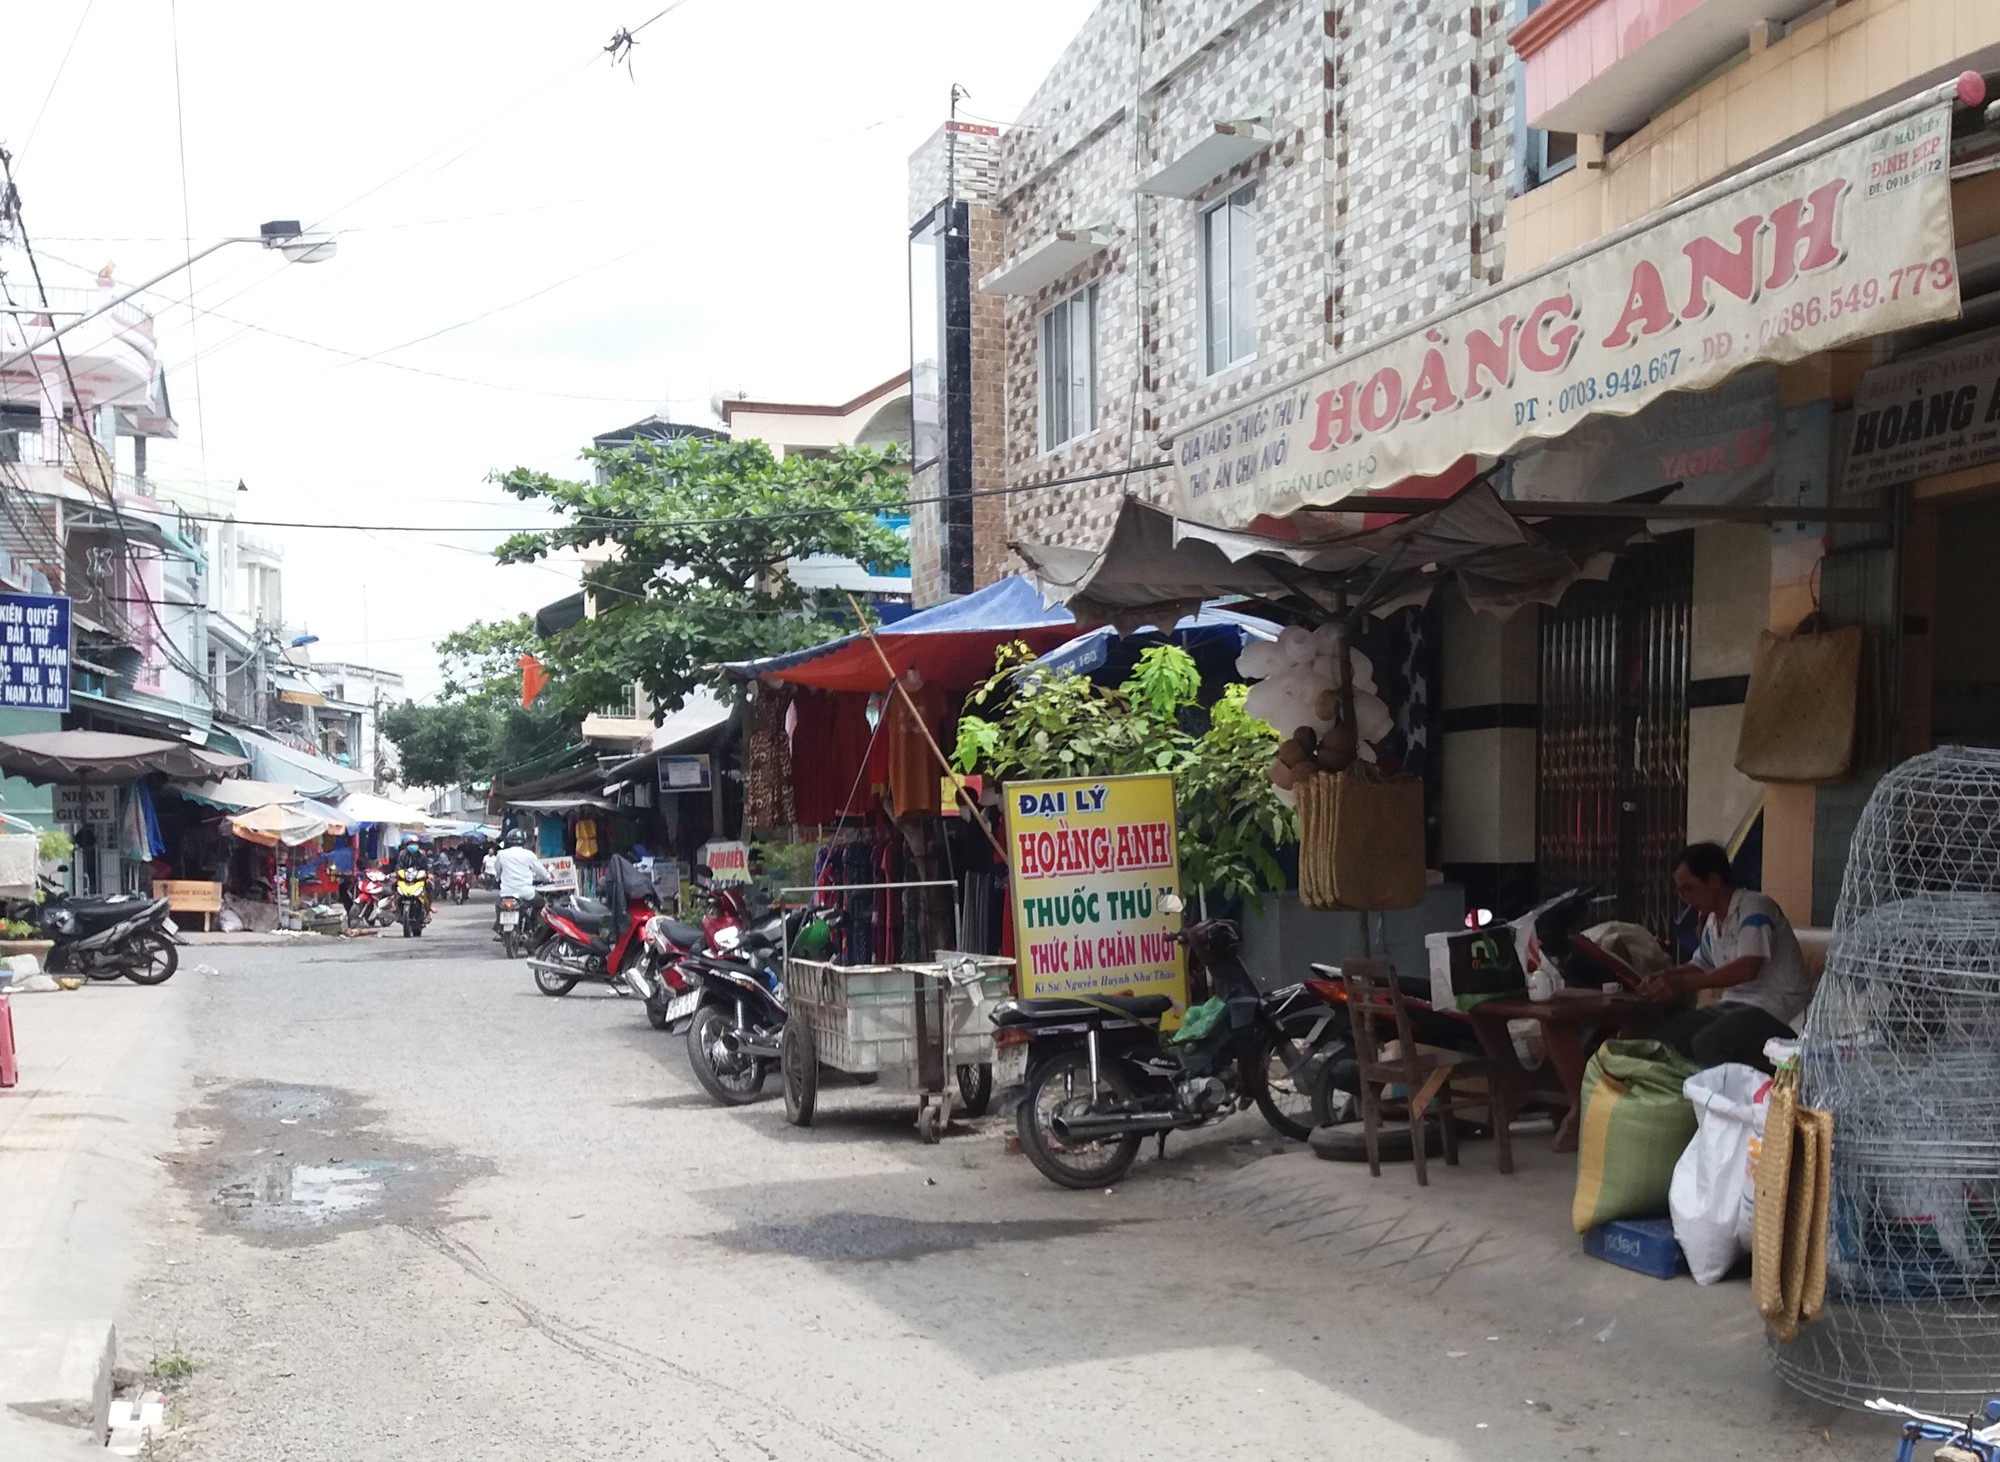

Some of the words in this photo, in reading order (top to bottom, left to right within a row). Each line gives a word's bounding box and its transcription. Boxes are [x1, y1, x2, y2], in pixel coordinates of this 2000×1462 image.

[1309, 293, 1583, 452] HOÀNG
[1602, 177, 1851, 350] ANH
[1558, 348, 1682, 414] 0703.942.667
[1852, 385, 1978, 456] HOÀNG
[1317, 463, 1353, 490] LONG
[26, 604, 59, 627] QUYẾT
[1079, 649, 1098, 668] 160
[88, 808, 110, 820] XE
[1019, 791, 1066, 818] ĐẠI
[1076, 785, 1107, 812] LÝ
[1019, 819, 1112, 876] HOÀNG
[1117, 822, 1171, 868] ANH
[1023, 885, 1100, 928] THUỐC
[1106, 882, 1152, 921] THÚ
[1030, 936, 1069, 975] THỨC
[1073, 933, 1094, 972] ĂN
[1098, 930, 1136, 968] CHĂN
[1140, 926, 1175, 964] NUÔI
